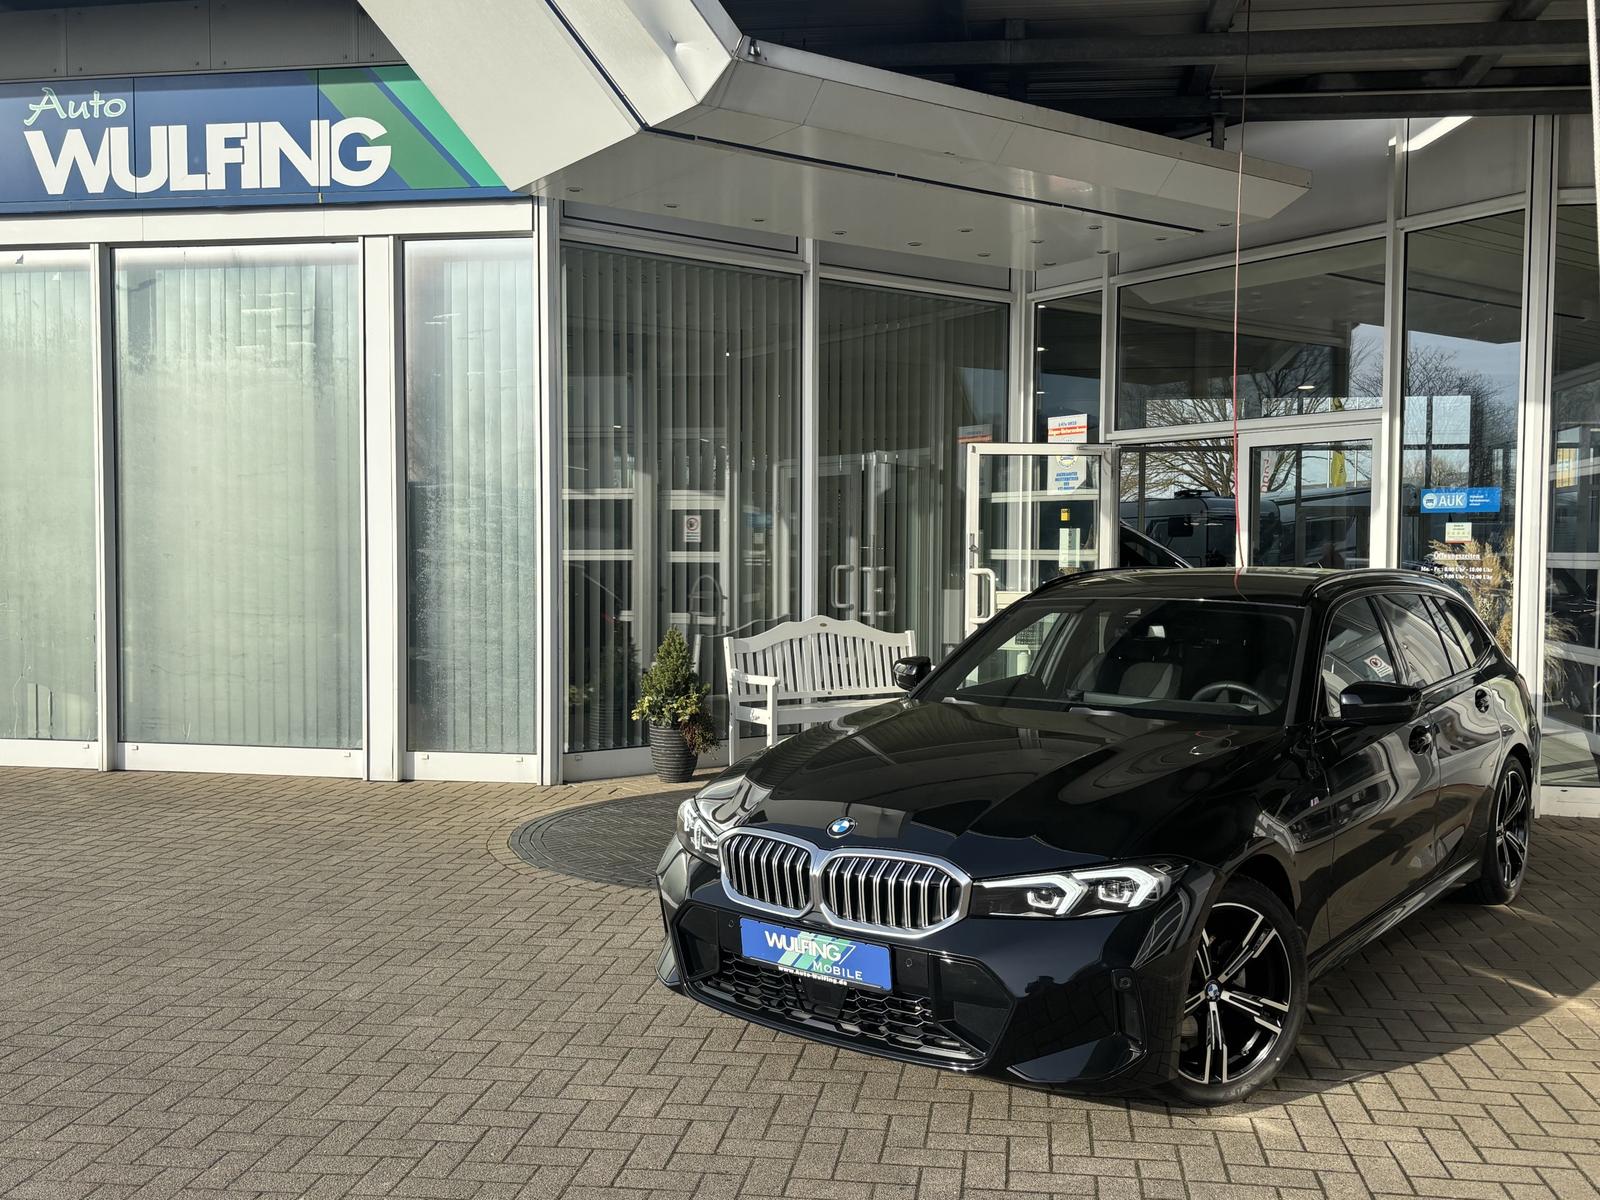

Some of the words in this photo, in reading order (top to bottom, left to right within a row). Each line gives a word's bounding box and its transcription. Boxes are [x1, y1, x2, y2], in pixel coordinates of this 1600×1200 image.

[23, 87, 127, 126] Auto
[23, 116, 392, 195] WULFING
[764, 931, 842, 961] WULFING
[813, 961, 863, 981] MOBILE
